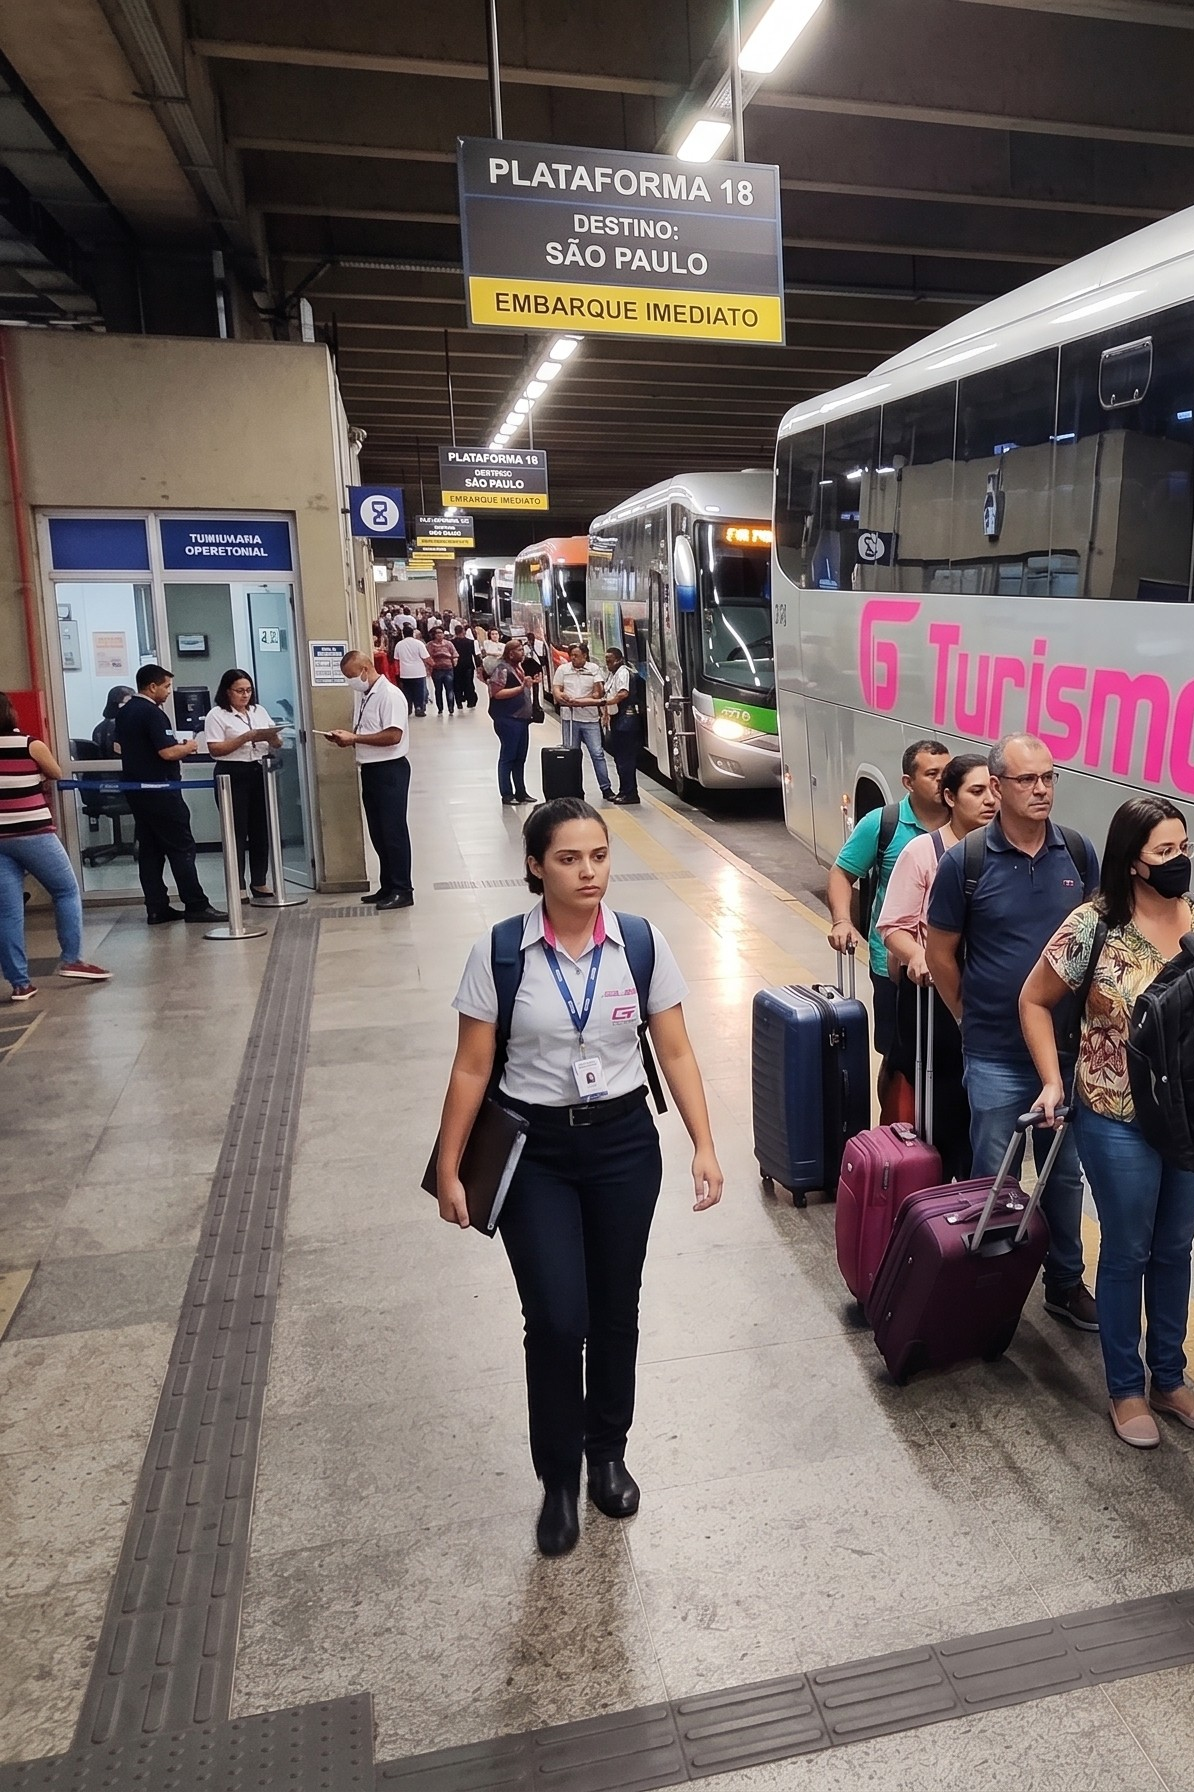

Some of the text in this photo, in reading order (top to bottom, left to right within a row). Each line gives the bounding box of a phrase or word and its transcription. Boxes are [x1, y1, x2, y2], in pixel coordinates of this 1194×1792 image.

[488, 157, 754, 206] PLATAFORMA 18
[573, 213, 679, 241] DESTINO:
[545, 238, 709, 276] SÃO PAULO
[495, 292, 759, 328] EMBARQUE IMEDIATO
[448, 452, 539, 465] PLATAFORMA 18
[489, 479, 524, 489] PAULO
[500, 496, 541, 505] IMEDIATO
